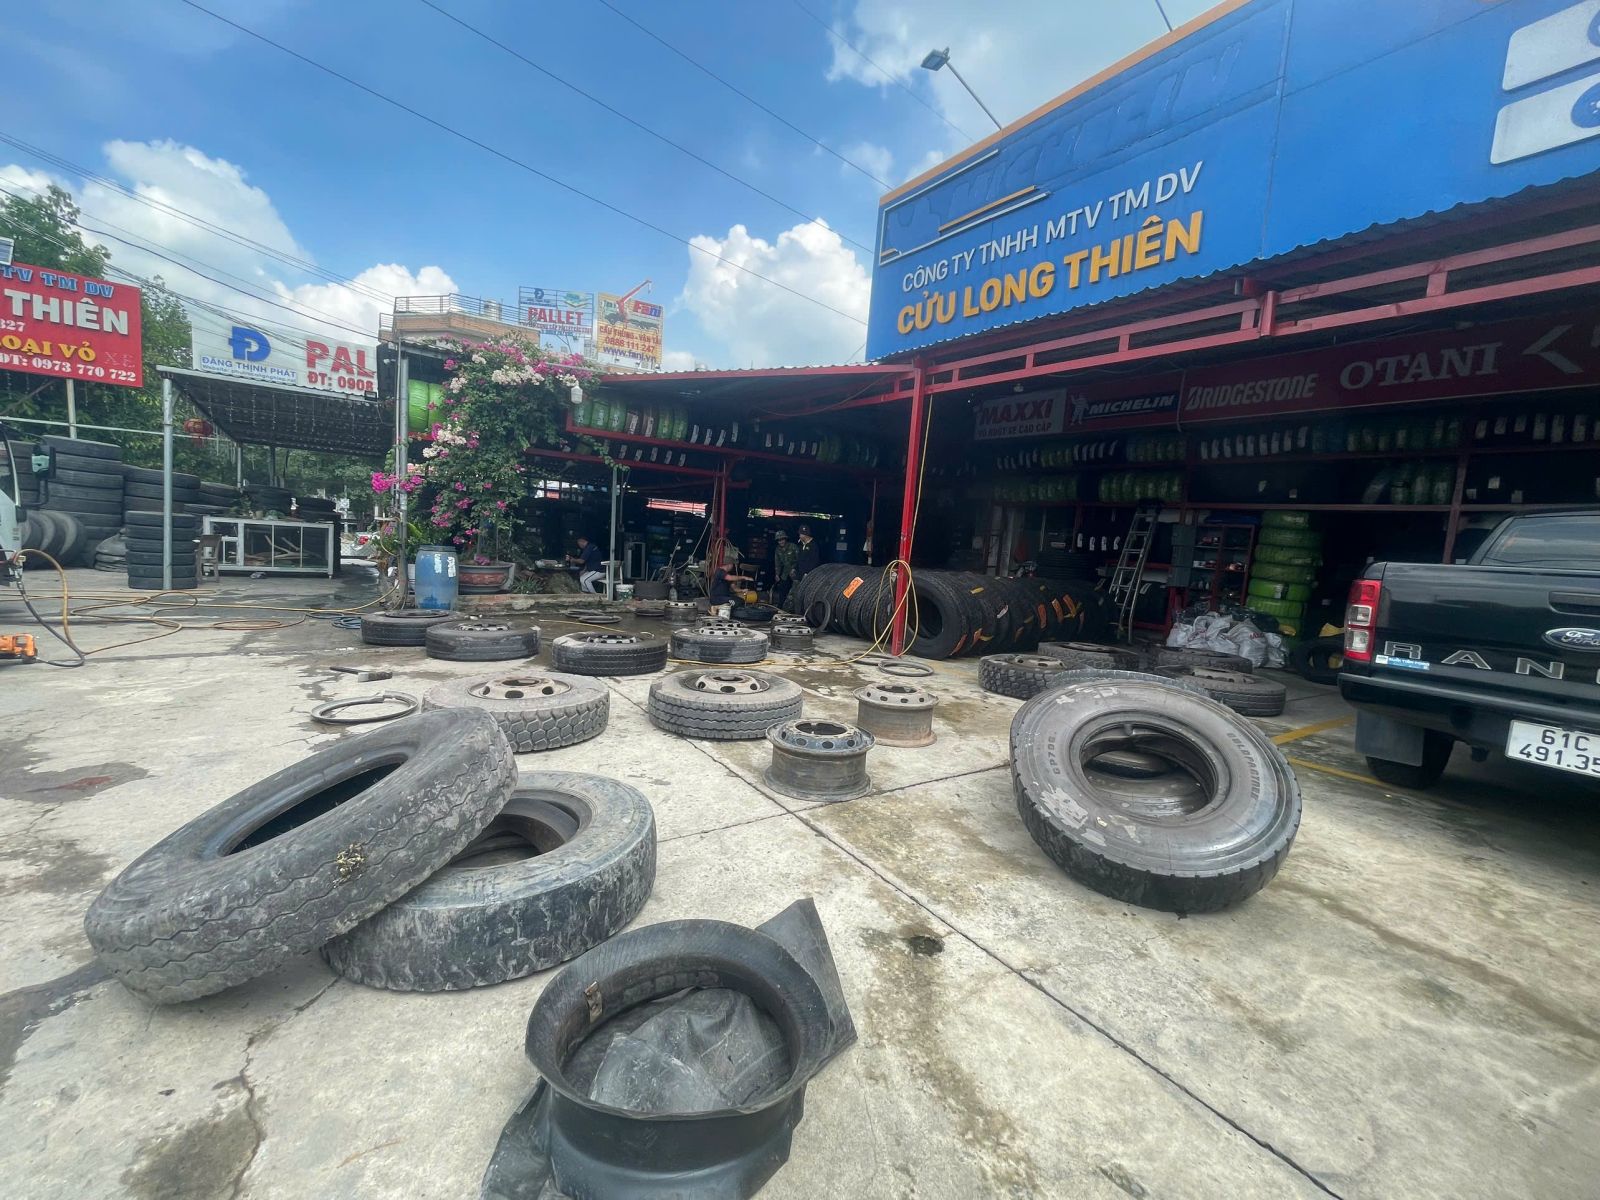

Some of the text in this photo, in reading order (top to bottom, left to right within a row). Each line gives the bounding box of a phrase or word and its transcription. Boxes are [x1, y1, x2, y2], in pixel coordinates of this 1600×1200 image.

[902, 160, 1204, 292] CÔNG TY TNHH MTV TM DV
[40, 271, 78, 291] TM
[84, 280, 114, 298] DV
[897, 210, 1205, 335] CỬU LONG THIÊN
[4, 288, 129, 335] THIÊN
[528, 306, 584, 326] PALLET
[0, 335, 52, 356] OẠI
[58, 340, 96, 362] VỎ
[32, 357, 72, 373] 0973
[77, 364, 105, 377] 770
[109, 368, 136, 382] 722
[1339, 342, 1502, 390] OTANI
[1088, 394, 1175, 416] MICHELIN
[1185, 372, 1319, 411] BRIDGESTONE
[1384, 640, 1600, 684] RAN
[1541, 729, 1591, 751] 61C
